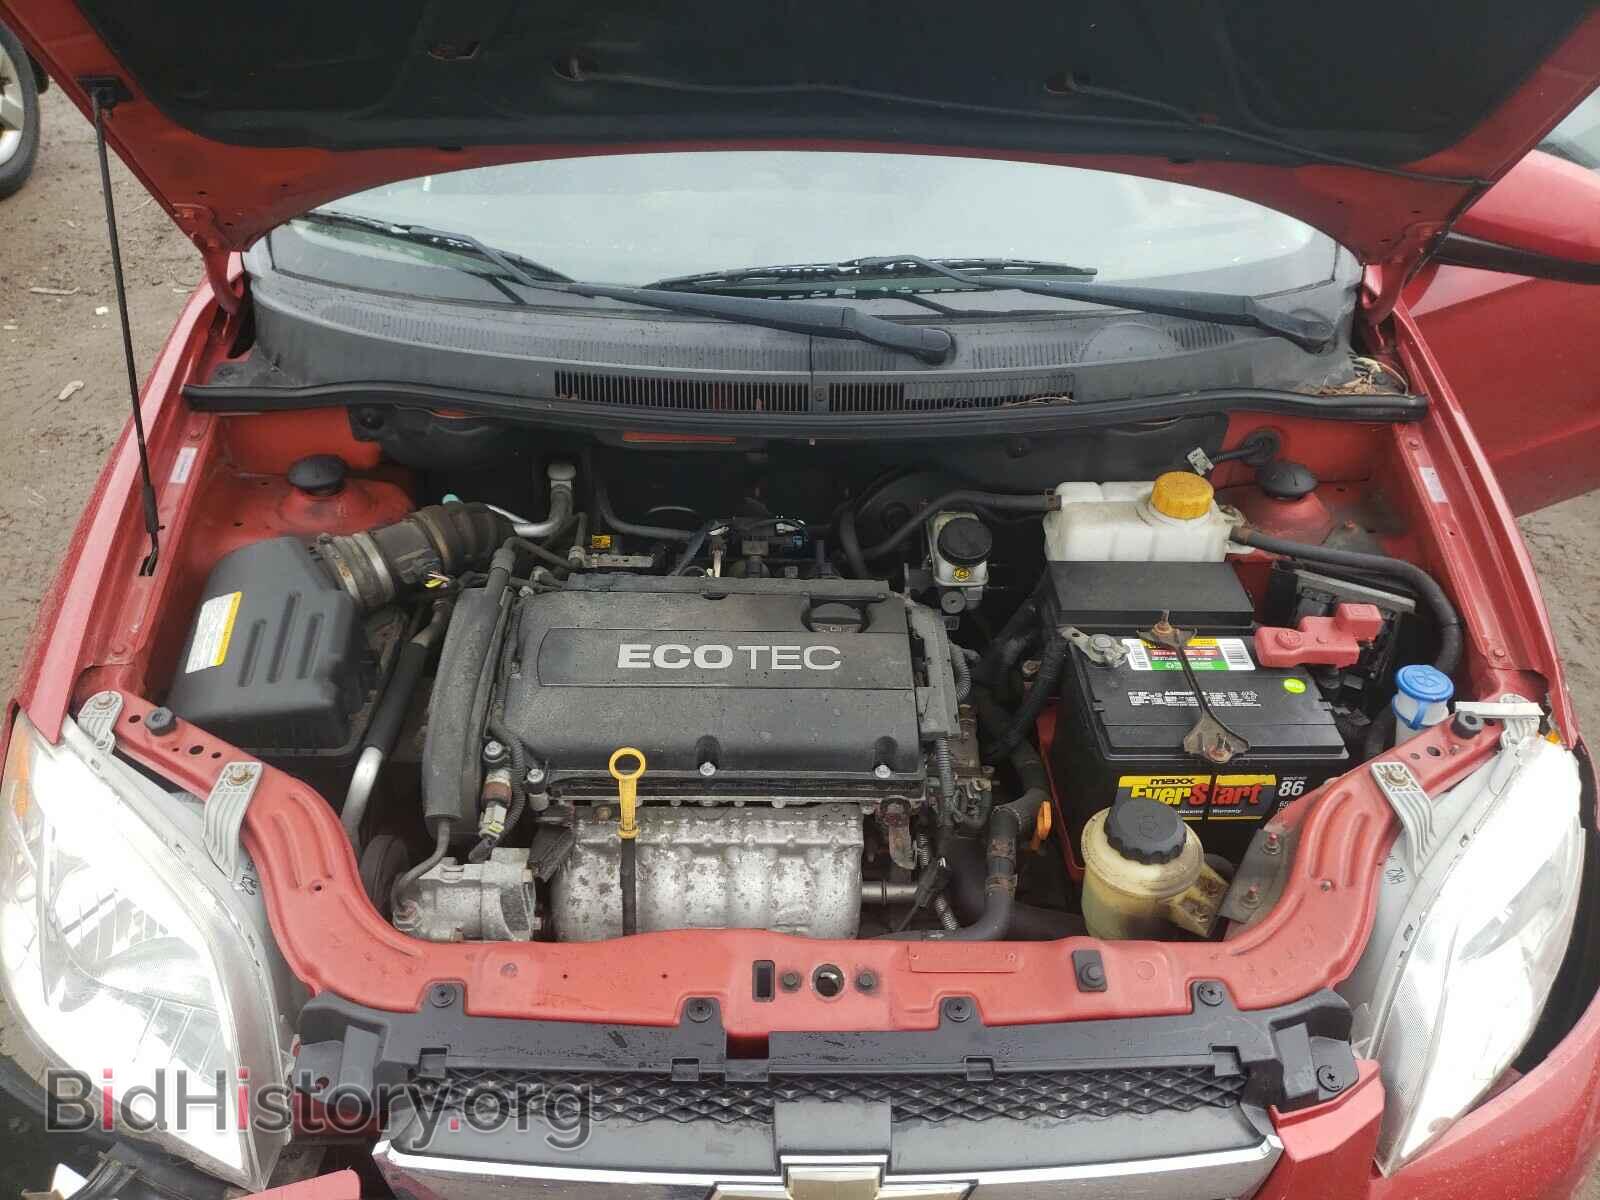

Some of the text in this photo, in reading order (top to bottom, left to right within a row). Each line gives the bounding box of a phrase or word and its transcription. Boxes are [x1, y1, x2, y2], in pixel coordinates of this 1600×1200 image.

[617, 643, 841, 670] ECOTEC
[1150, 777, 1195, 785] maxx
[1278, 780, 1305, 797] 86
[1130, 783, 1264, 806] EverStart
